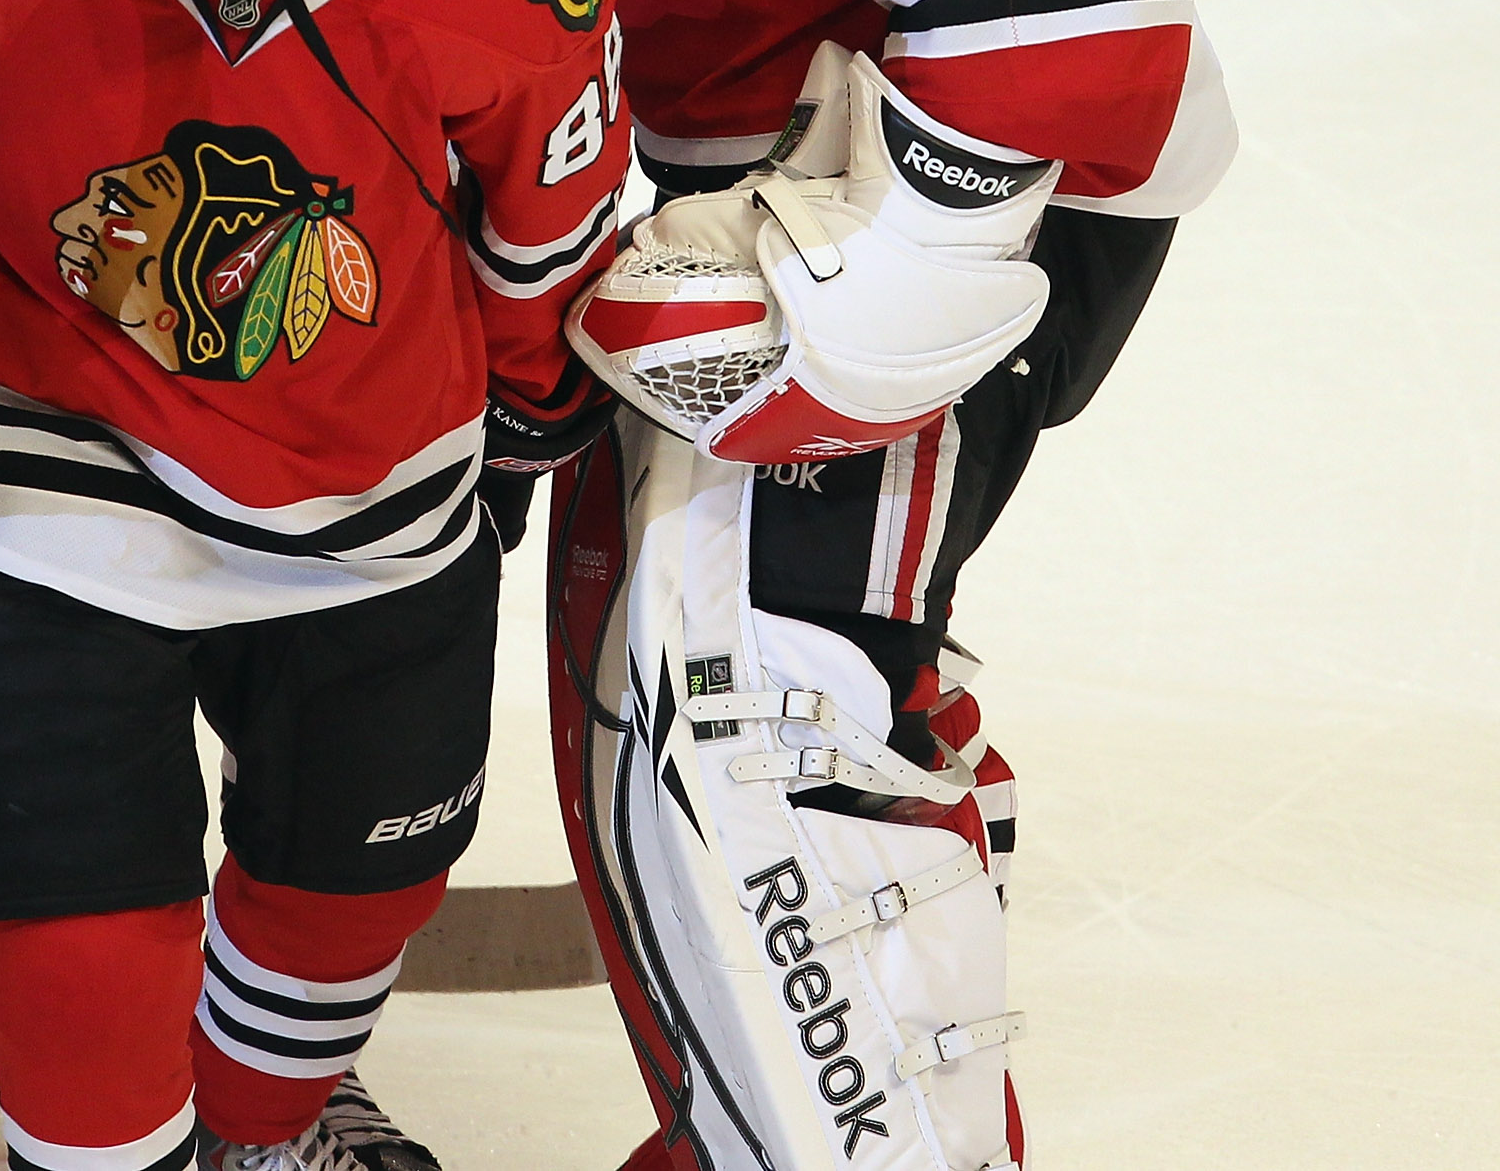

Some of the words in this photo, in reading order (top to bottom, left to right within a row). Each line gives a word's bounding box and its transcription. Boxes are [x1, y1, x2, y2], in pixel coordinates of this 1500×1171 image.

[902, 139, 1018, 198] Reebok
[492, 406, 529, 433] KANE
[364, 763, 485, 844] BAUE
[743, 855, 894, 1162] Reebok
